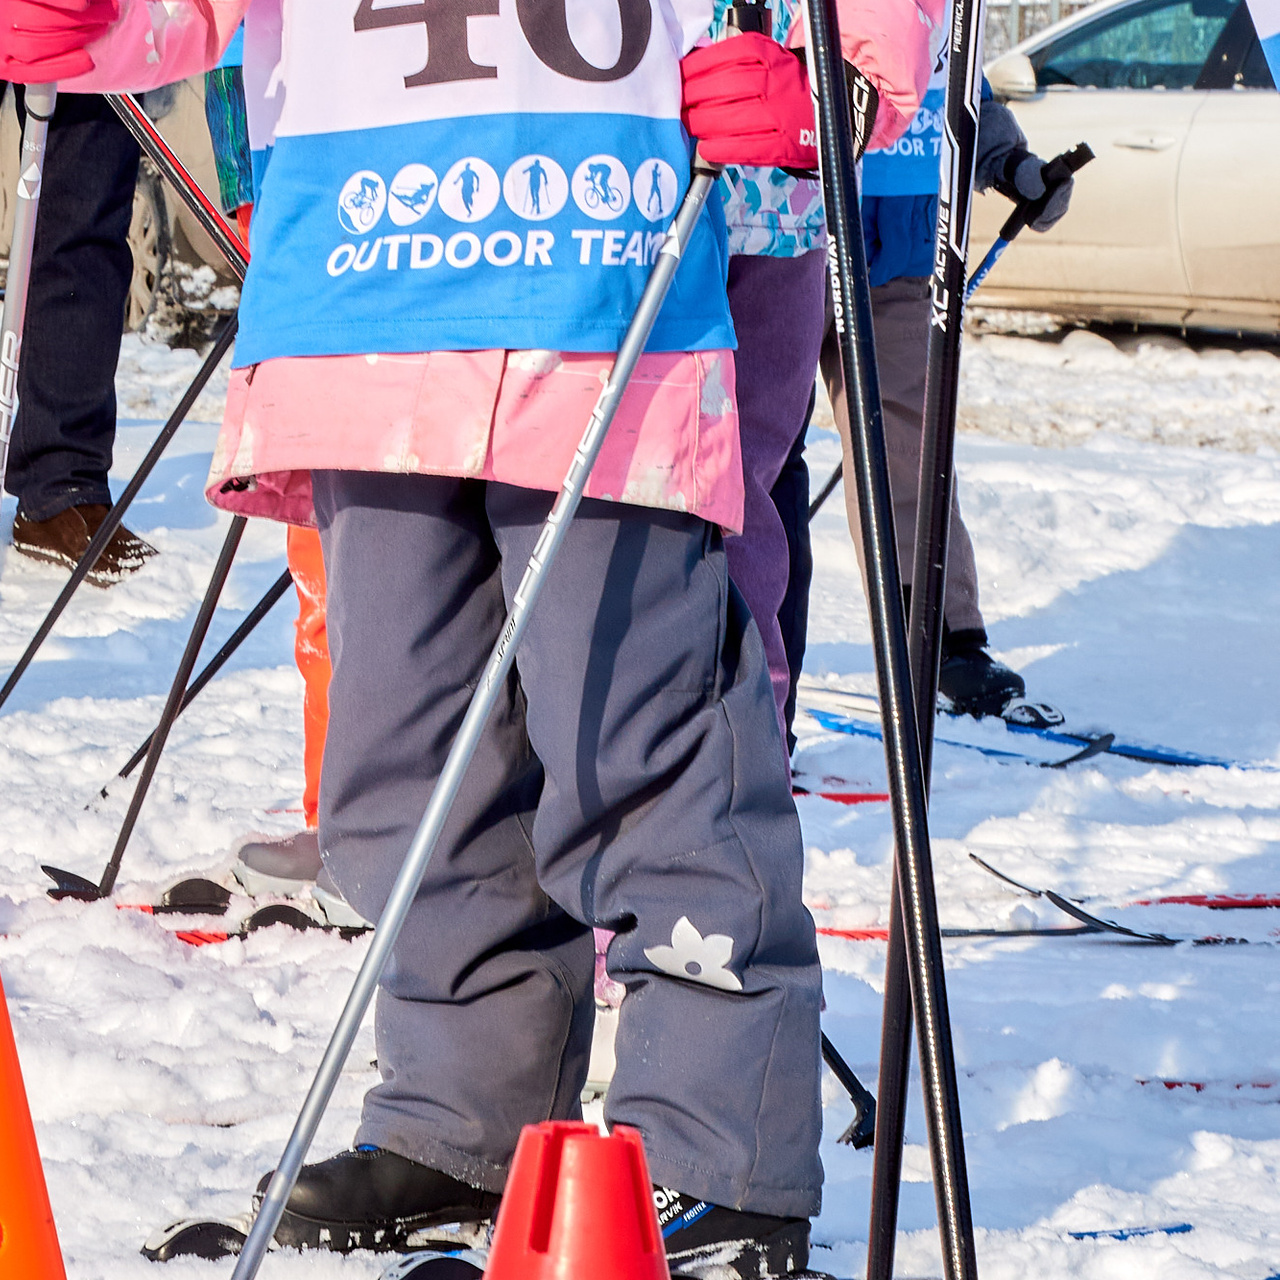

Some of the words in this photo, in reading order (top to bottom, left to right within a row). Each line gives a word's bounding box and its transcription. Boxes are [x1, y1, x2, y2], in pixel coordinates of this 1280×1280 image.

[327, 229, 555, 278] OUTDOOR
[934, 204, 951, 283] ACTIVE
[931, 287, 950, 333] XC
